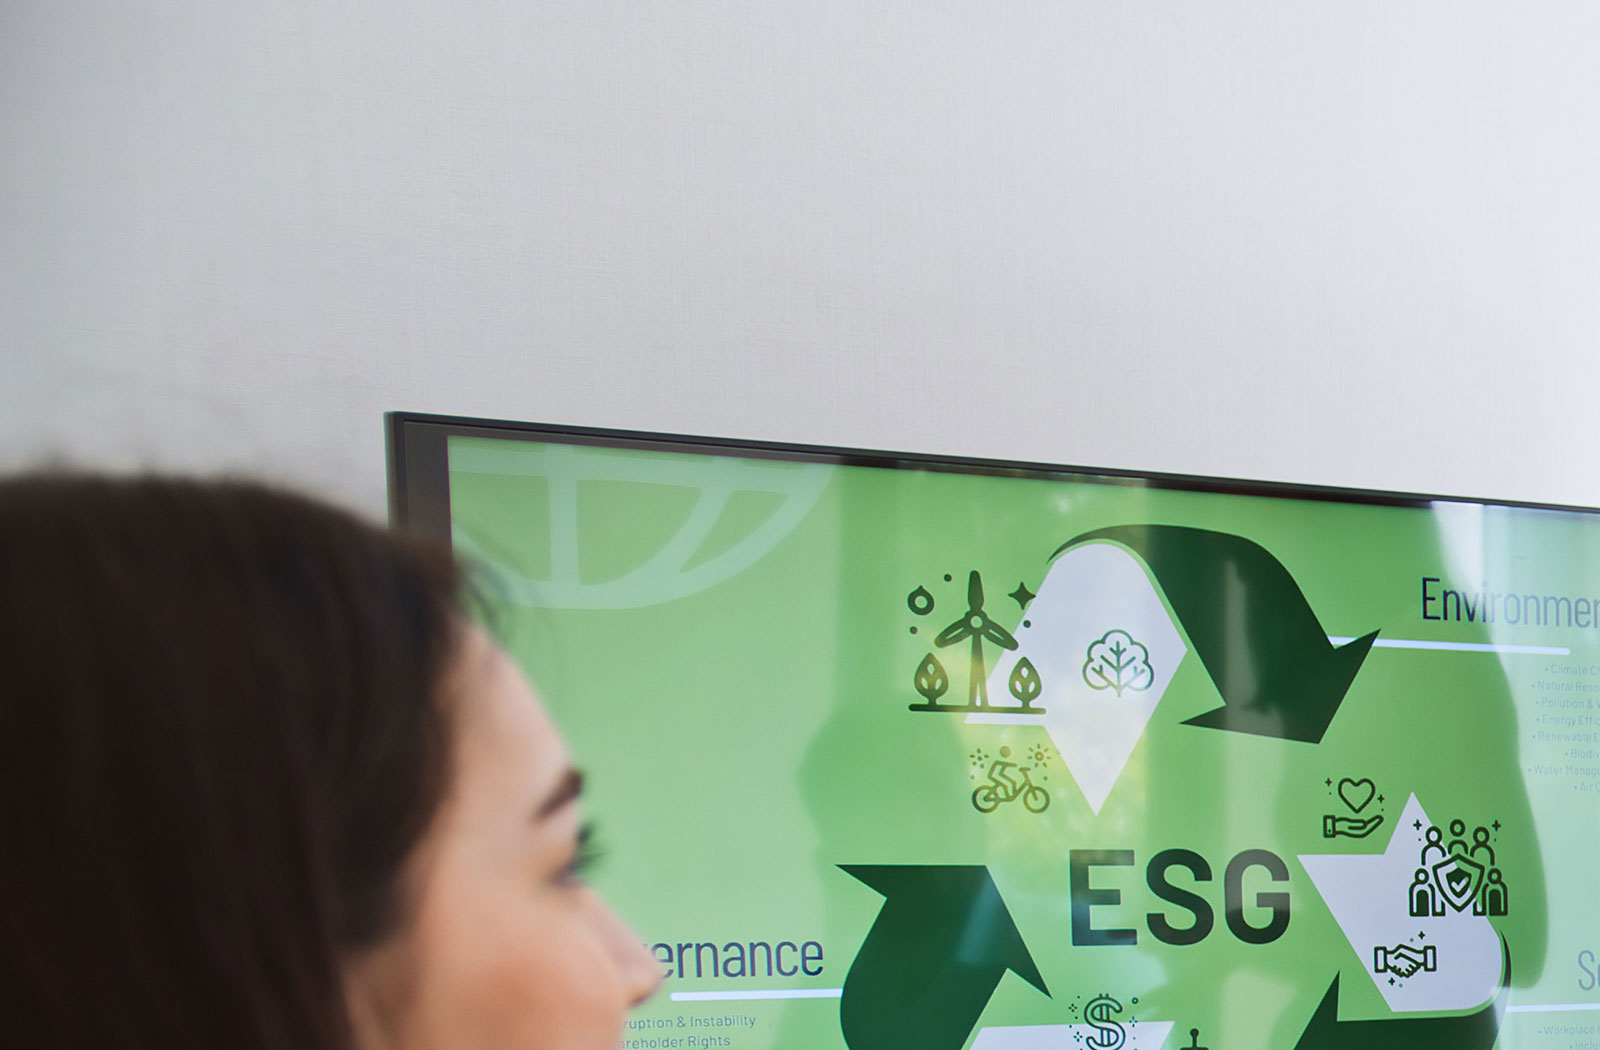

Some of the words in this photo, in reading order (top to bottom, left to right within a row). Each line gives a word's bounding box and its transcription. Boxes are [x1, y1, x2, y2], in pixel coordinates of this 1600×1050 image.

[1551, 664, 1587, 675] Climate
[1537, 681, 1573, 692] Natural
[1541, 697, 1584, 709] Pollution
[1586, 699, 1593, 709] &
[1542, 714, 1576, 726] Energy
[1538, 731, 1591, 743] Renewable
[1533, 765, 1563, 776] Water
[1579, 782, 1592, 792] Air
[1069, 848, 1292, 947] ESG
[643, 940, 825, 980] ernance
[623, 1017, 673, 1030] ruption
[677, 1017, 686, 1028] &
[690, 1014, 757, 1029] Instability
[1543, 1025, 1595, 1036] Workplace
[688, 1035, 731, 1050] Rights
